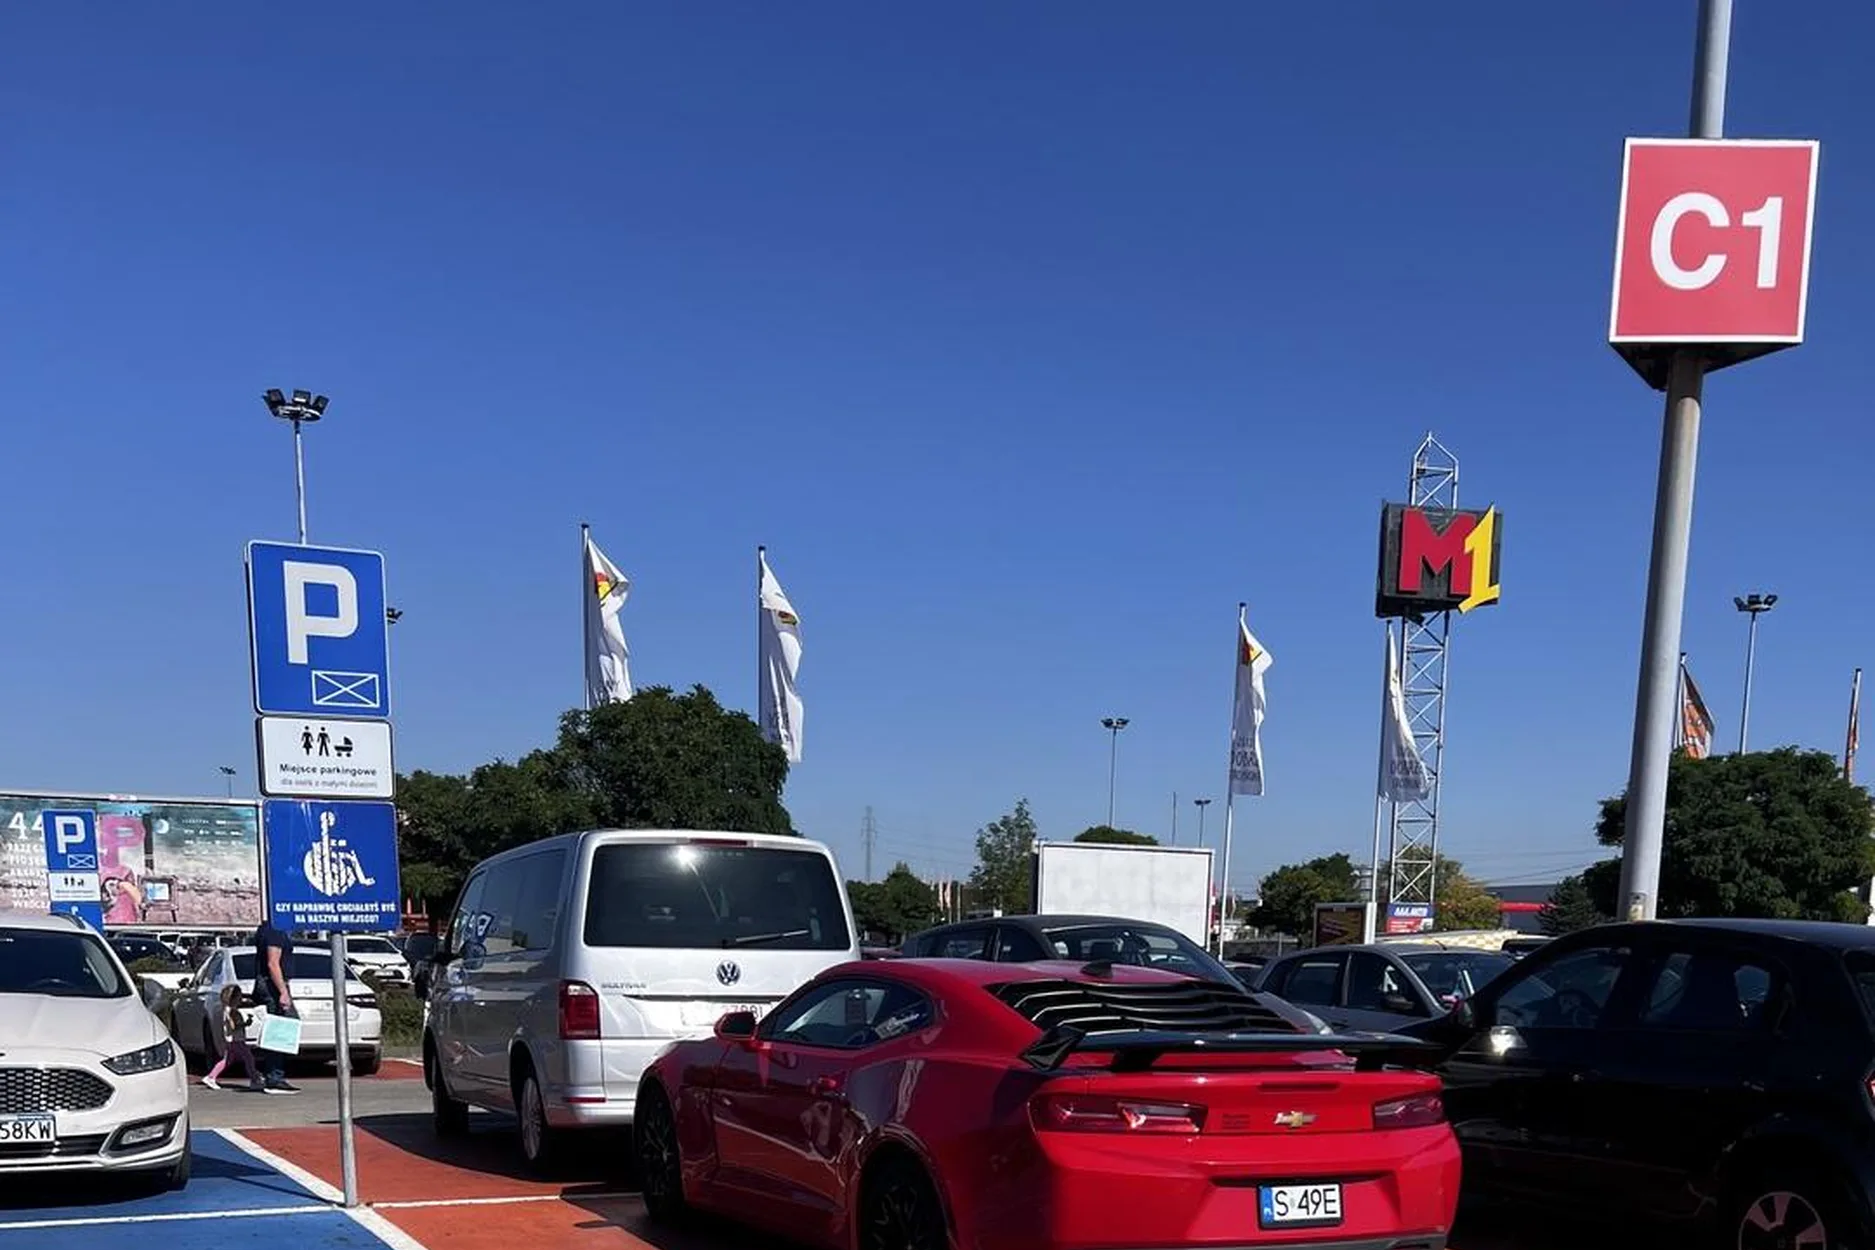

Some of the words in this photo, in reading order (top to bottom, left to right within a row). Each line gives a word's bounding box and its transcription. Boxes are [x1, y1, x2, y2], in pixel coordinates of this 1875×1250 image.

[1651, 191, 1783, 290] C1
[1399, 505, 1500, 614] M1
[283, 560, 358, 664] P
[280, 764, 317, 774] Miejsce
[320, 766, 377, 777] parkingowe
[55, 815, 86, 854] P
[275, 902, 291, 912] CZY
[295, 914, 306, 924] NA
[307, 914, 339, 924] NASZYM
